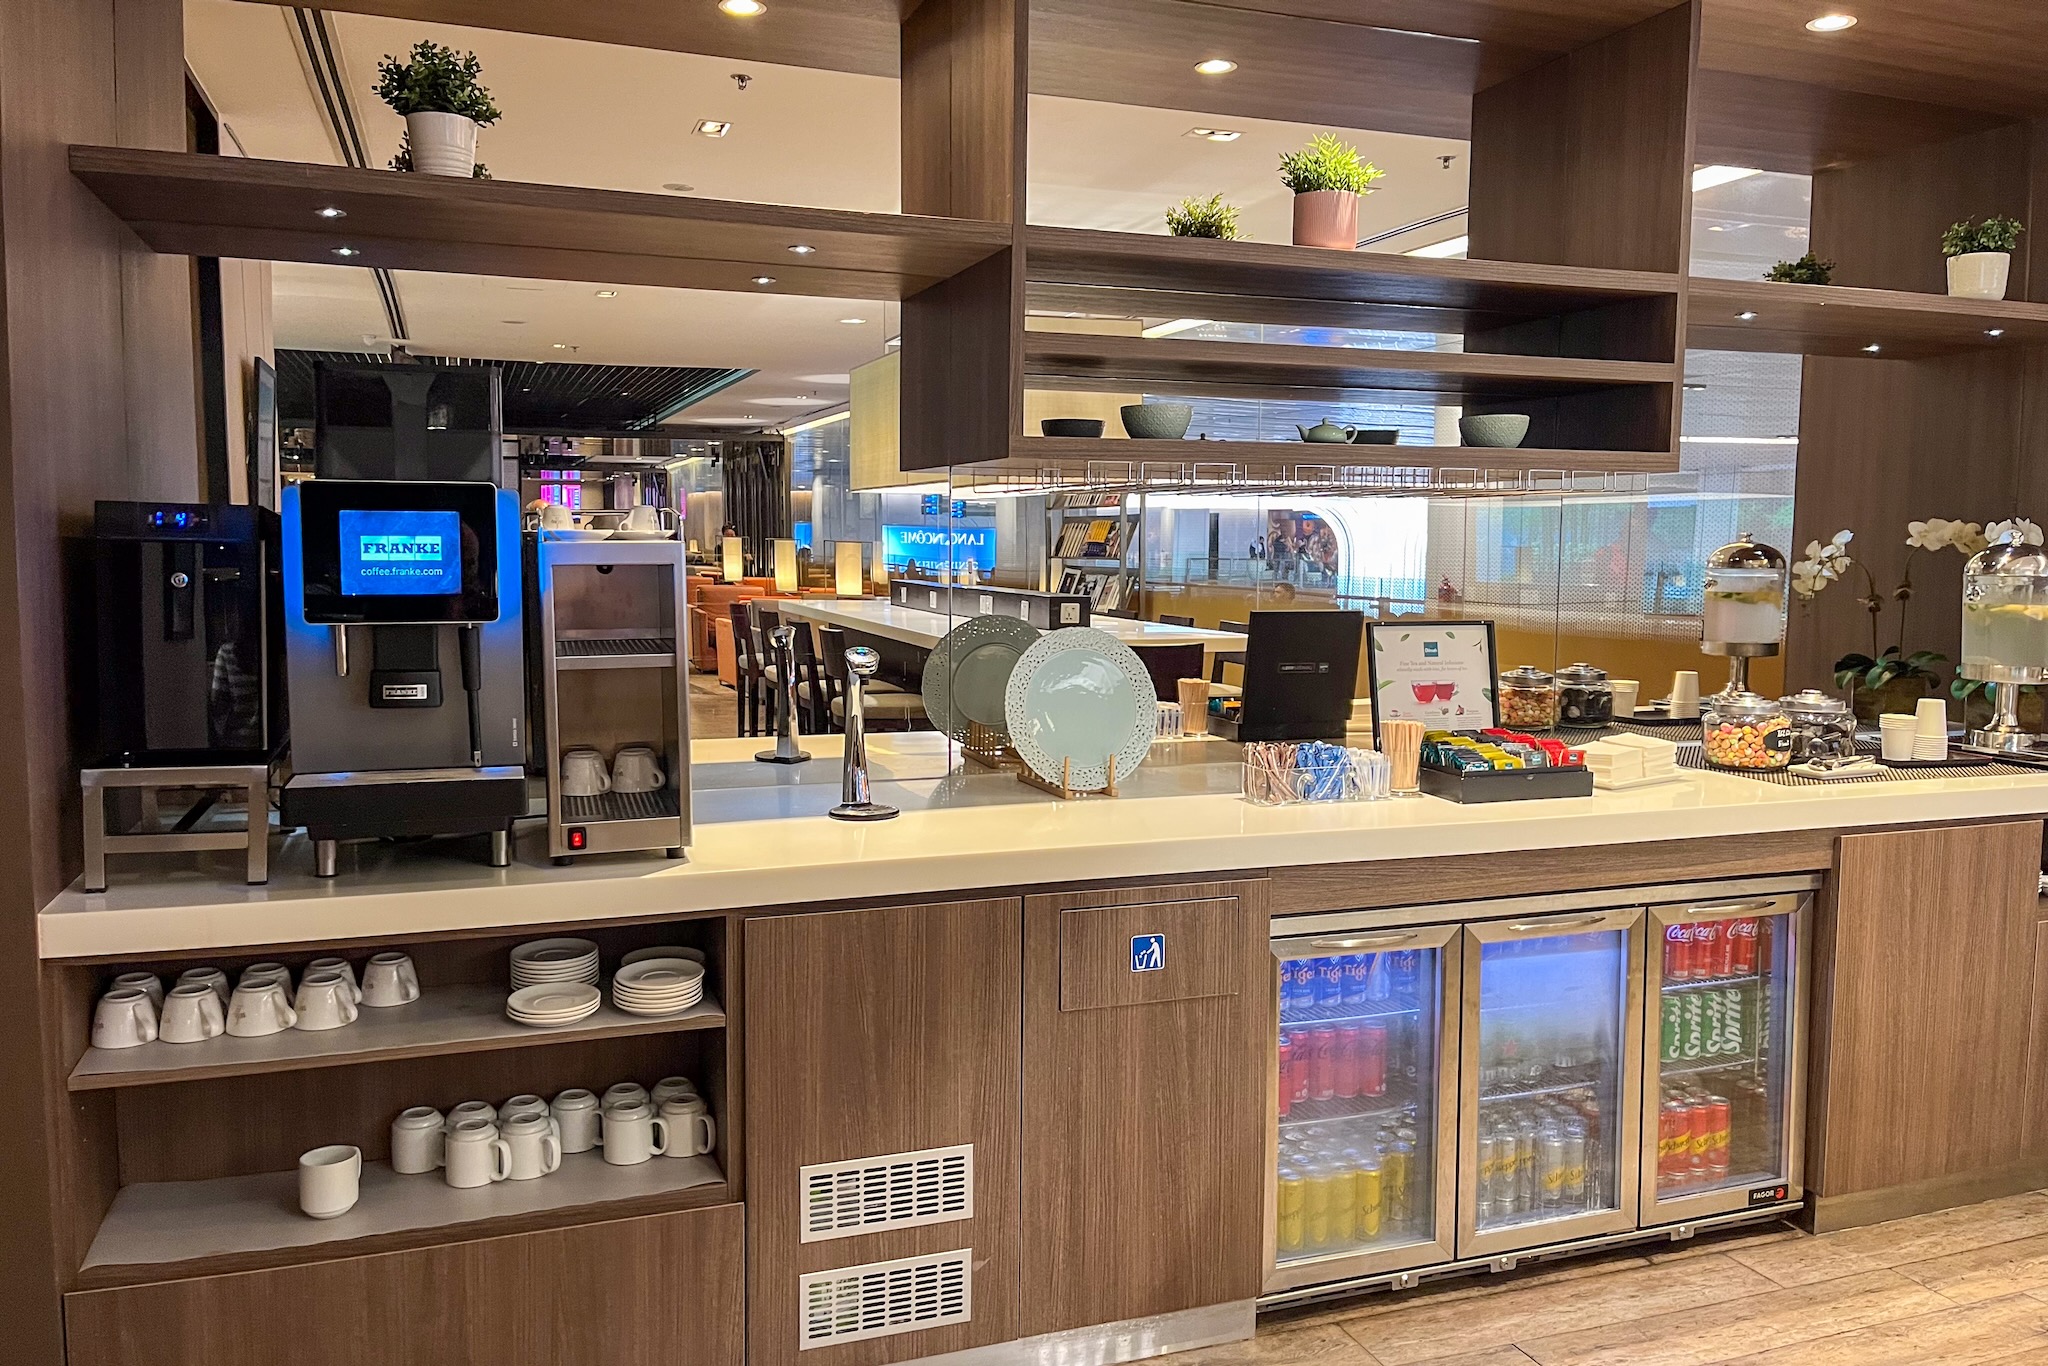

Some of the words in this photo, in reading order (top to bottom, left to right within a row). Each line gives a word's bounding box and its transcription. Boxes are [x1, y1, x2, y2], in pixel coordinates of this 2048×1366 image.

[363, 543, 440, 554] FRANKE
[361, 566, 443, 577] coffee.franke.com
[1720, 989, 1742, 1053] Sprite
[1753, 1190, 1774, 1199] FAGOR
